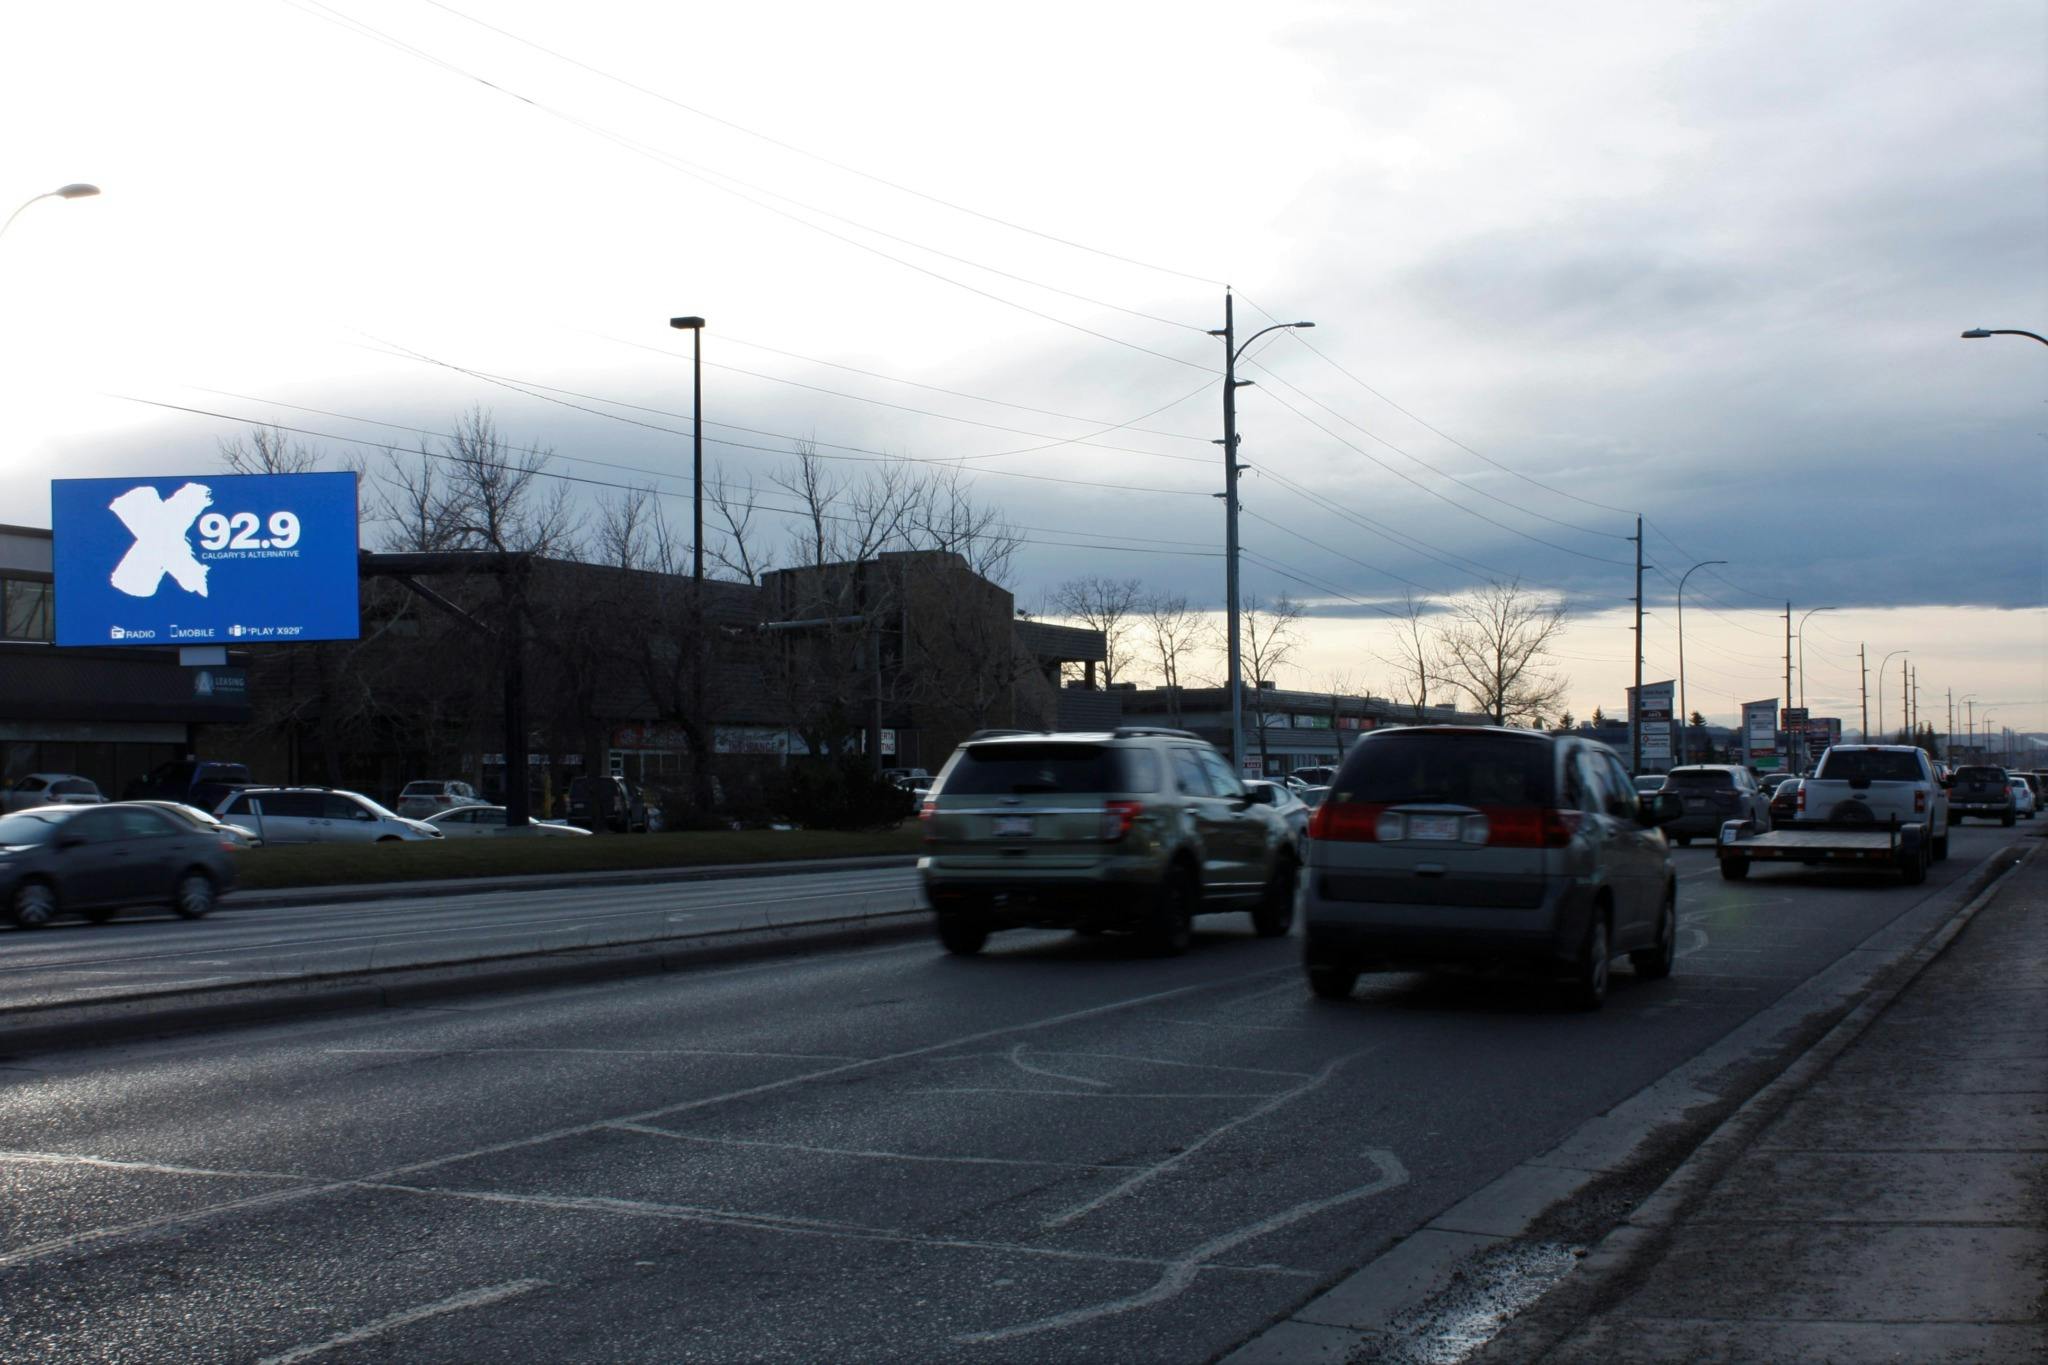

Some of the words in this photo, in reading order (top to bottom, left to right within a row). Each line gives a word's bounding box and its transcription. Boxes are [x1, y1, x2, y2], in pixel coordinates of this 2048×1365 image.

[109, 482, 214, 598] X
[200, 511, 301, 550] 92.9
[201, 551, 246, 560] CALGARY'S
[247, 549, 300, 559] ALTERNATIVE
[126, 630, 156, 639] RADIO
[179, 628, 215, 638] MOBILE
[215, 677, 245, 686] LEASING
